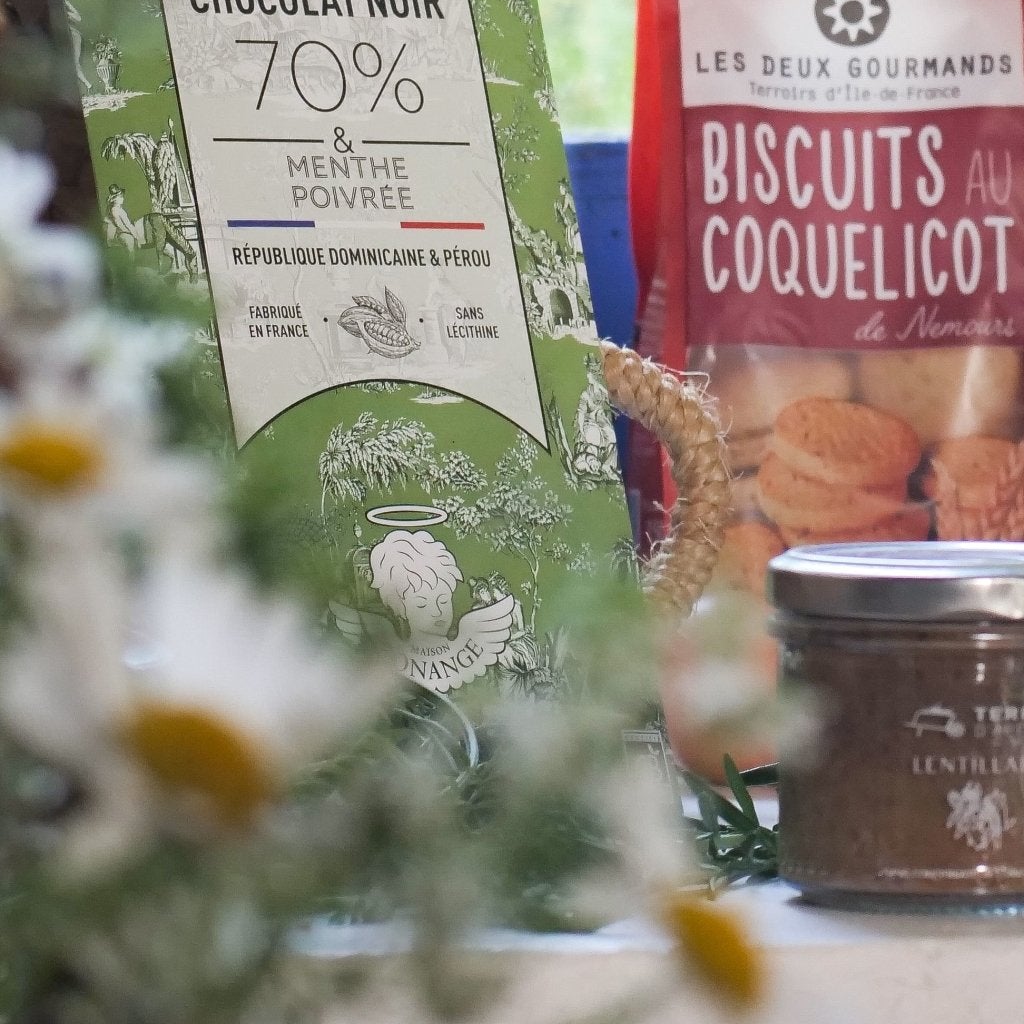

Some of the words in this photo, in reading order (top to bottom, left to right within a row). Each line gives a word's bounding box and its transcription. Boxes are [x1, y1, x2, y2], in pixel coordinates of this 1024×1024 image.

[235, 40, 424, 113] 70%
[696, 51, 745, 73] LES
[762, 55, 830, 77] DEUX
[848, 54, 1012, 77] GOURMANDS
[749, 82, 816, 101] Terroirs
[333, 126, 355, 154] &
[286, 155, 409, 180] MENTHE
[703, 121, 945, 211] BISCUITS
[966, 150, 1012, 205] AU
[291, 183, 415, 210] POIVRÉE
[232, 243, 326, 266] RÉPUBLIQUE
[329, 247, 427, 267] DOMINICAINE
[429, 249, 442, 267] &
[443, 245, 491, 267] PÉROU
[703, 215, 1015, 300] COQUELICOT
[249, 303, 303, 320] FABRIQUÉ
[455, 307, 484, 320] SANS
[249, 323, 264, 338] EN
[266, 323, 309, 338] FRANCE
[446, 321, 499, 339] LÉCITHINE
[855, 310, 887, 342] de
